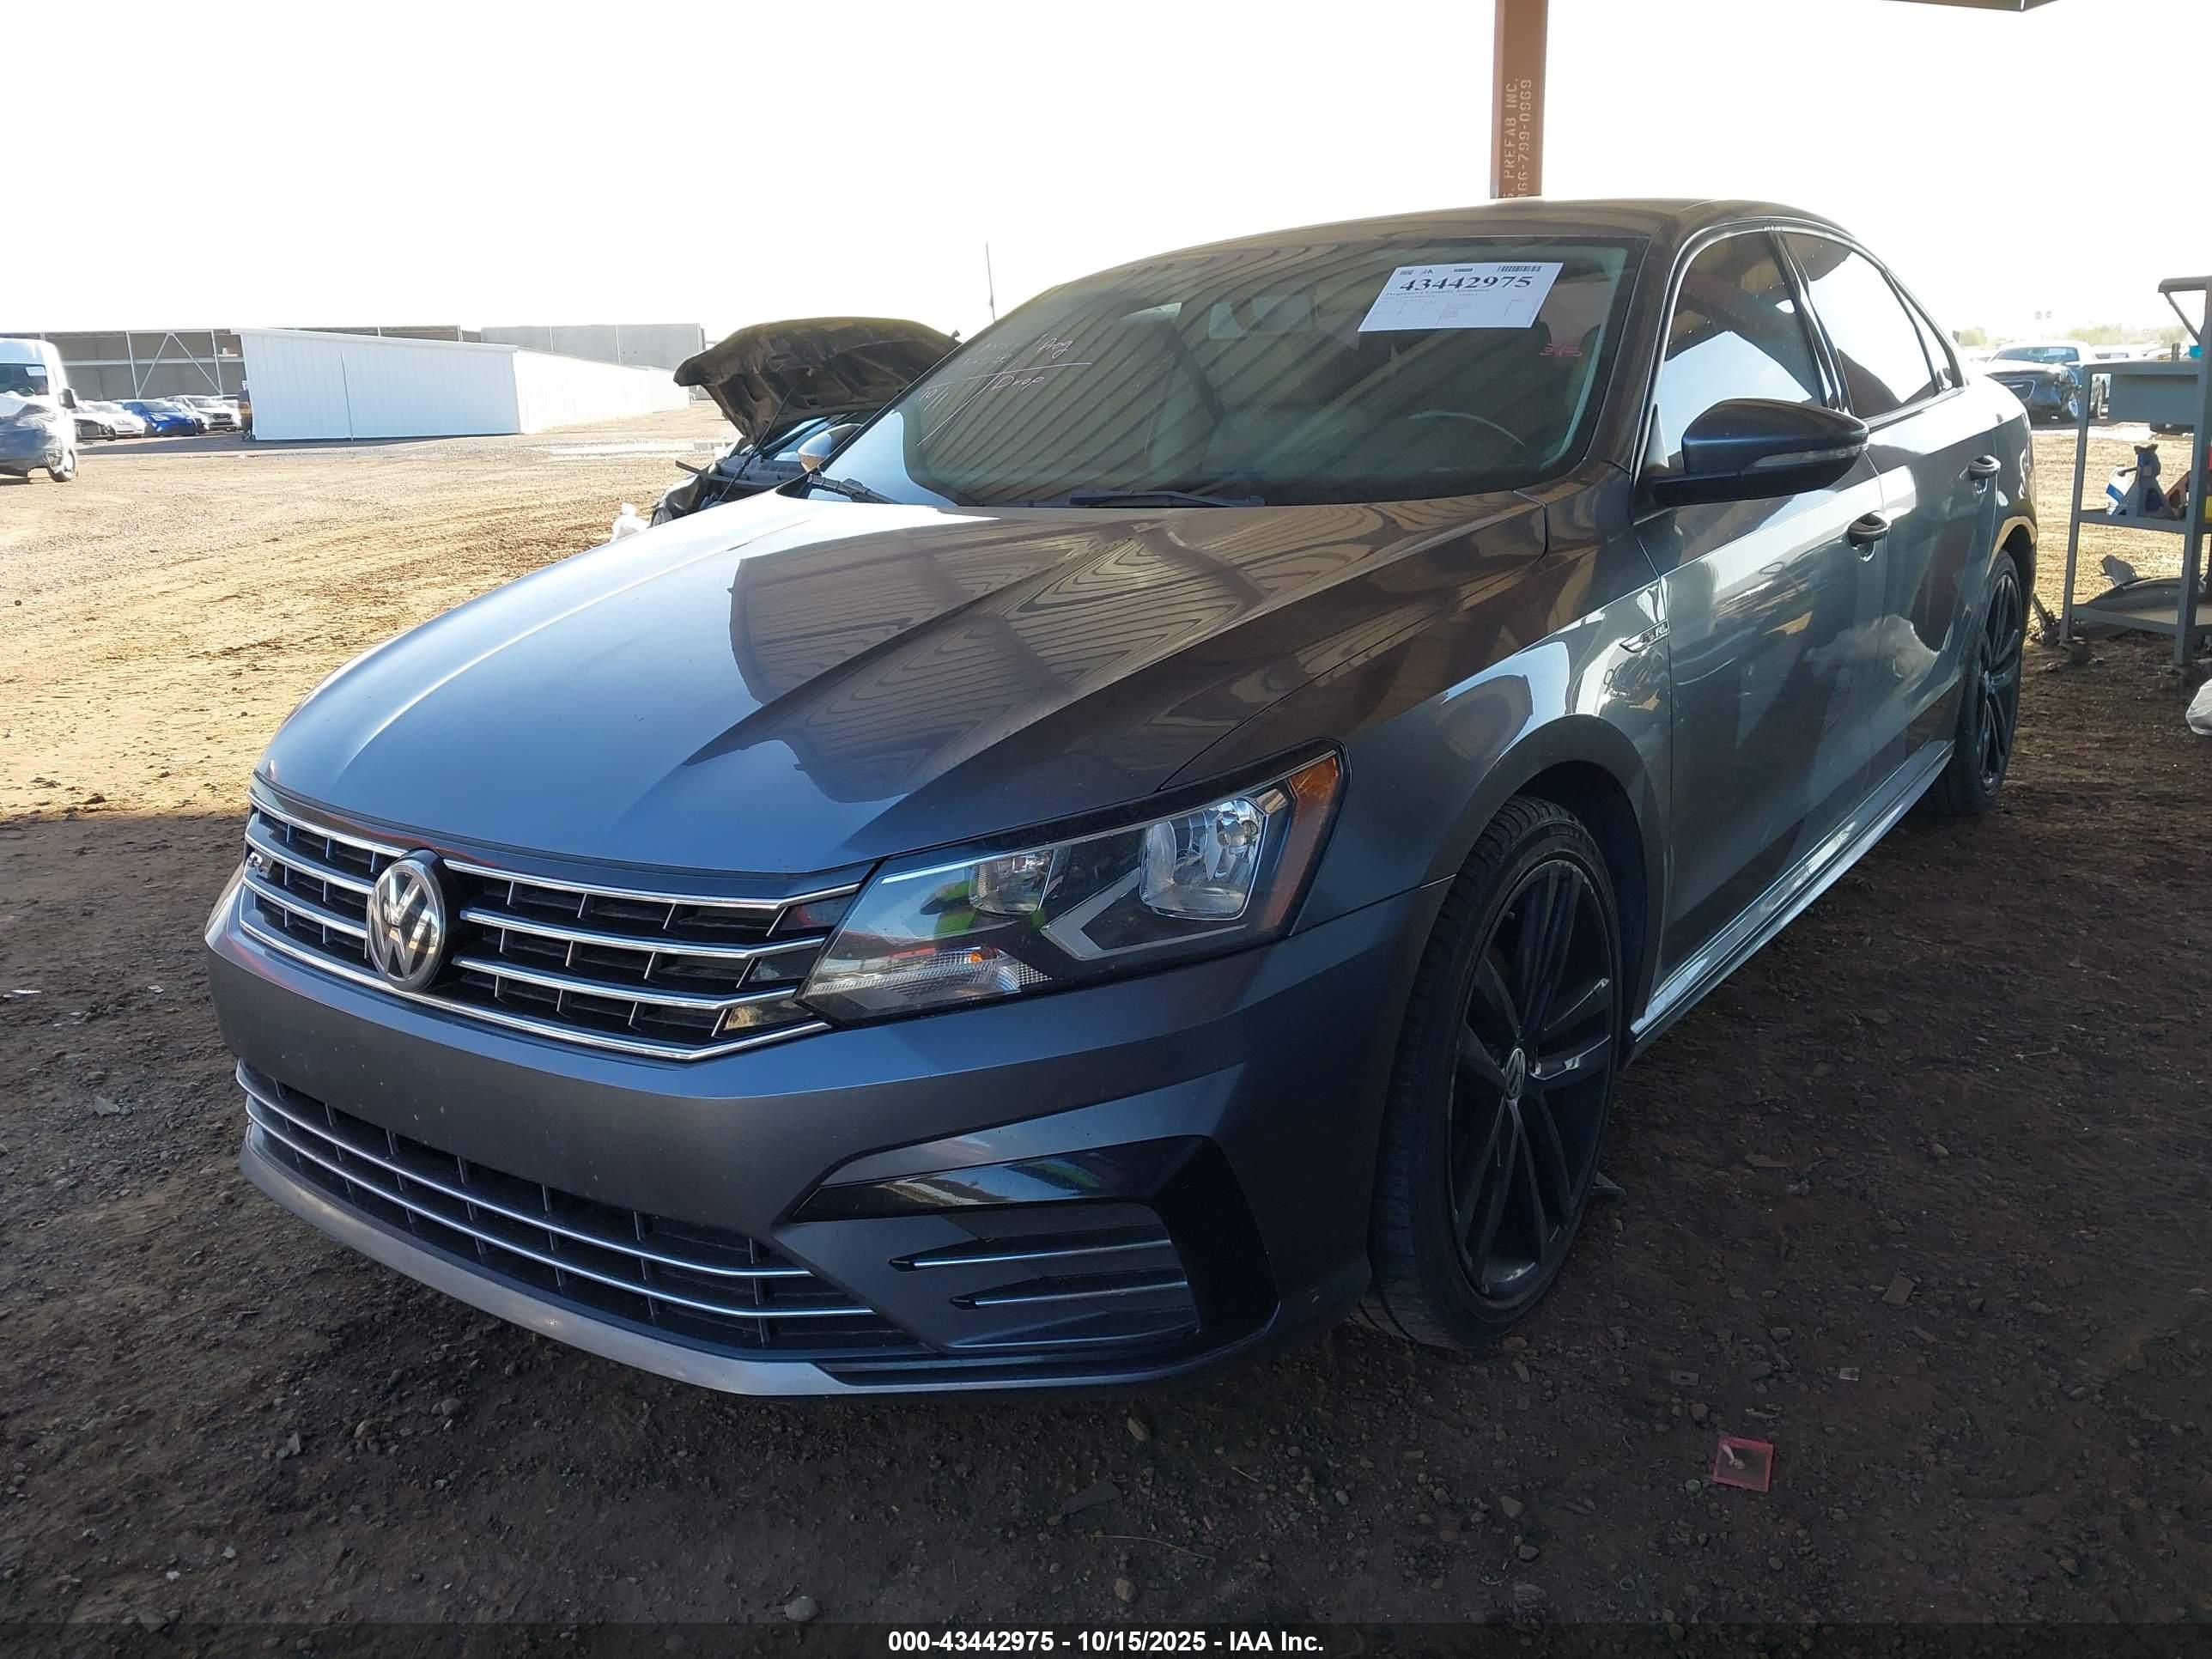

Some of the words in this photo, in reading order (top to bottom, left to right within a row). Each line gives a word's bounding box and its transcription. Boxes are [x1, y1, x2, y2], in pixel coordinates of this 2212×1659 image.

[1505, 78, 1518, 108] INC.
[1504, 117, 1517, 179] PREFAB
[1400, 275, 1534, 291] 43442975
